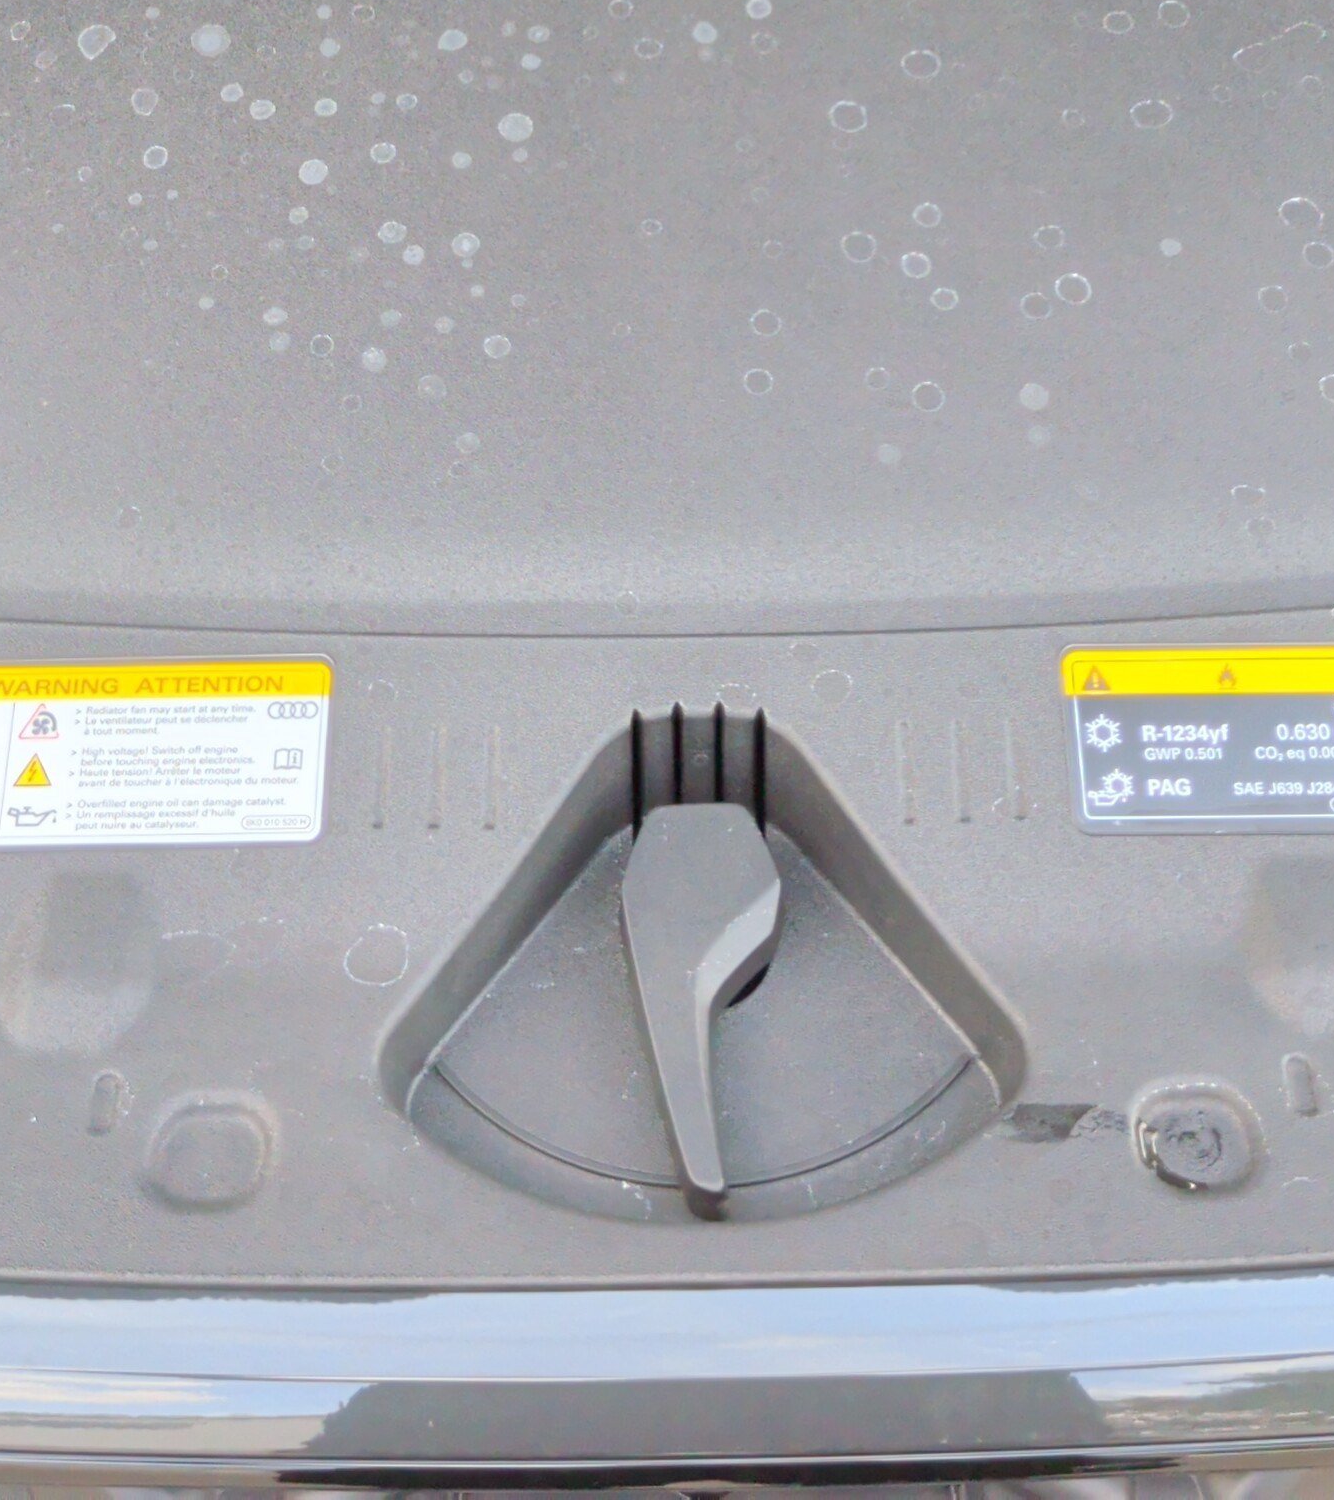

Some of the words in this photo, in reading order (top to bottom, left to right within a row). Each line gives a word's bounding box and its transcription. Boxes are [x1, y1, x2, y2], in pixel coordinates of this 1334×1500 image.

[135, 675, 284, 694] ATTENTION
[86, 705, 127, 715] Radiator
[130, 705, 147, 714] fan
[149, 706, 171, 716] may
[174, 705, 196, 714] start
[198, 705, 208, 713] at
[210, 705, 229, 715] any
[85, 716, 96, 725] Le
[99, 716, 152, 725] ventilateur
[155, 716, 177, 726] peut
[93, 727, 113, 735] tout
[1142, 724, 1228, 744] R-1234yf
[1276, 723, 1330, 741] 0.630
[81, 747, 105, 758] High
[152, 746, 185, 755] Switch
[188, 745, 202, 755] off
[203, 746, 238, 756] engine
[1144, 748, 1181, 761] GWP
[1185, 747, 1222, 760] 0.501
[1286, 749, 1306, 762] eq
[81, 757, 113, 766] before
[116, 756, 159, 767] touching
[162, 756, 197, 767] engine
[79, 768, 109, 777] Haute
[192, 766, 202, 775] le
[204, 766, 241, 775] moteur
[78, 779, 106, 788] avant
[109, 778, 121, 787] de
[124, 777, 162, 787] toucher
[244, 776, 258, 784] du
[1147, 778, 1192, 797] PAG
[1233, 782, 1265, 796] SAE
[1268, 781, 1303, 795] J639
[77, 799, 126, 809] Overfilled
[129, 799, 163, 809] engine
[166, 798, 179, 807] oil
[181, 799, 199, 807] can
[202, 798, 243, 807] damage
[76, 810, 91, 819] Un
[94, 809, 156, 820] remplissage
[158, 808, 198, 818] excessif
[75, 820, 98, 831] peut
[101, 821, 127, 829] nuire
[129, 821, 142, 829] au
